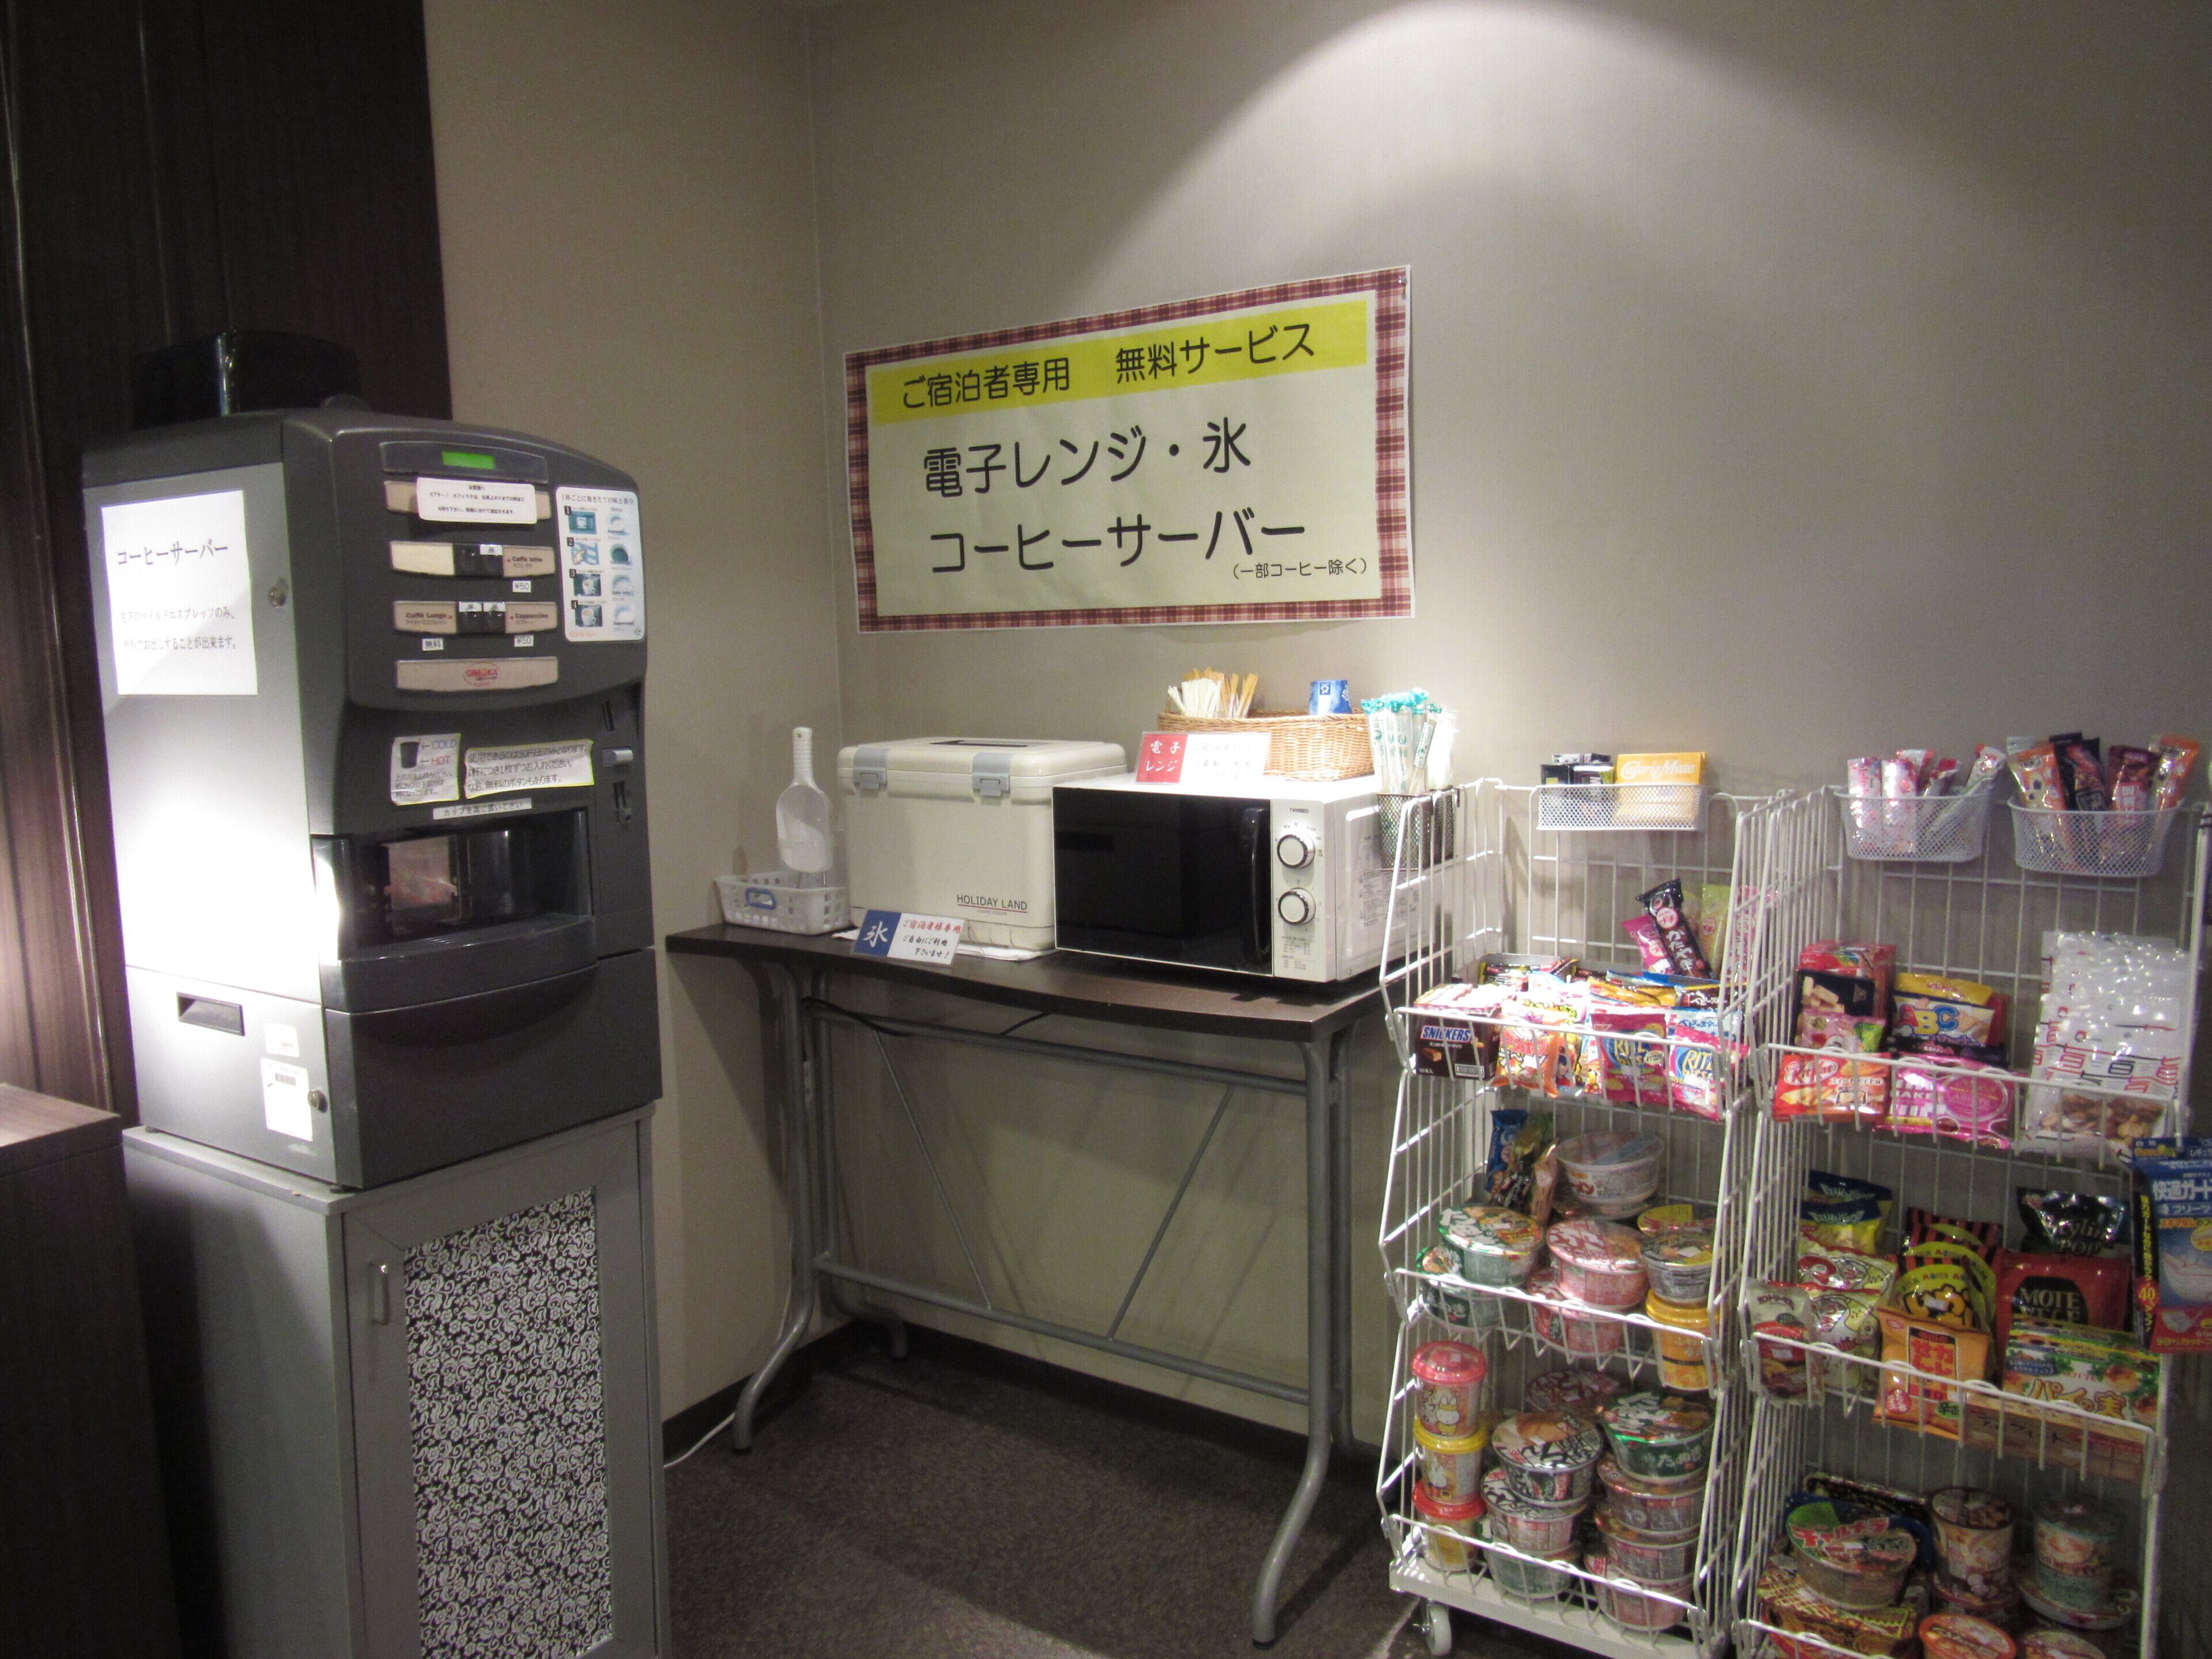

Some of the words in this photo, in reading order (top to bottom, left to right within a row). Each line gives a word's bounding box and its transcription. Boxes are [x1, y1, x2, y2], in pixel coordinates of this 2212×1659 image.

[903, 357, 1070, 410] ご宿泊者専用
[1116, 323, 1315, 384] 無料サービス
[924, 416, 1250, 497] 電子レンジ・氷
[930, 507, 1305, 574] コーヒーサーバー
[118, 539, 228, 565] コーヒーサーバー
[1232, 558, 1367, 580] （一部コーヒー除く）
[425, 640, 441, 649] 無料
[432, 739, 456, 749] COLD
[1150, 740, 1180, 754] 電子
[431, 755, 452, 766] HOT
[1146, 759, 1178, 772] レンジ
[957, 894, 998, 907] HOLIDAY
[1001, 899, 1028, 911] LAND
[903, 919, 962, 934] ご宿泊者様専用
[862, 922, 888, 948] 氷
[903, 935, 948, 946] ご自由にご利用
[1422, 1026, 1471, 1041] SNIKERS
[2019, 1287, 2080, 1308] MOTE
[2138, 1287, 2156, 1300] 40
